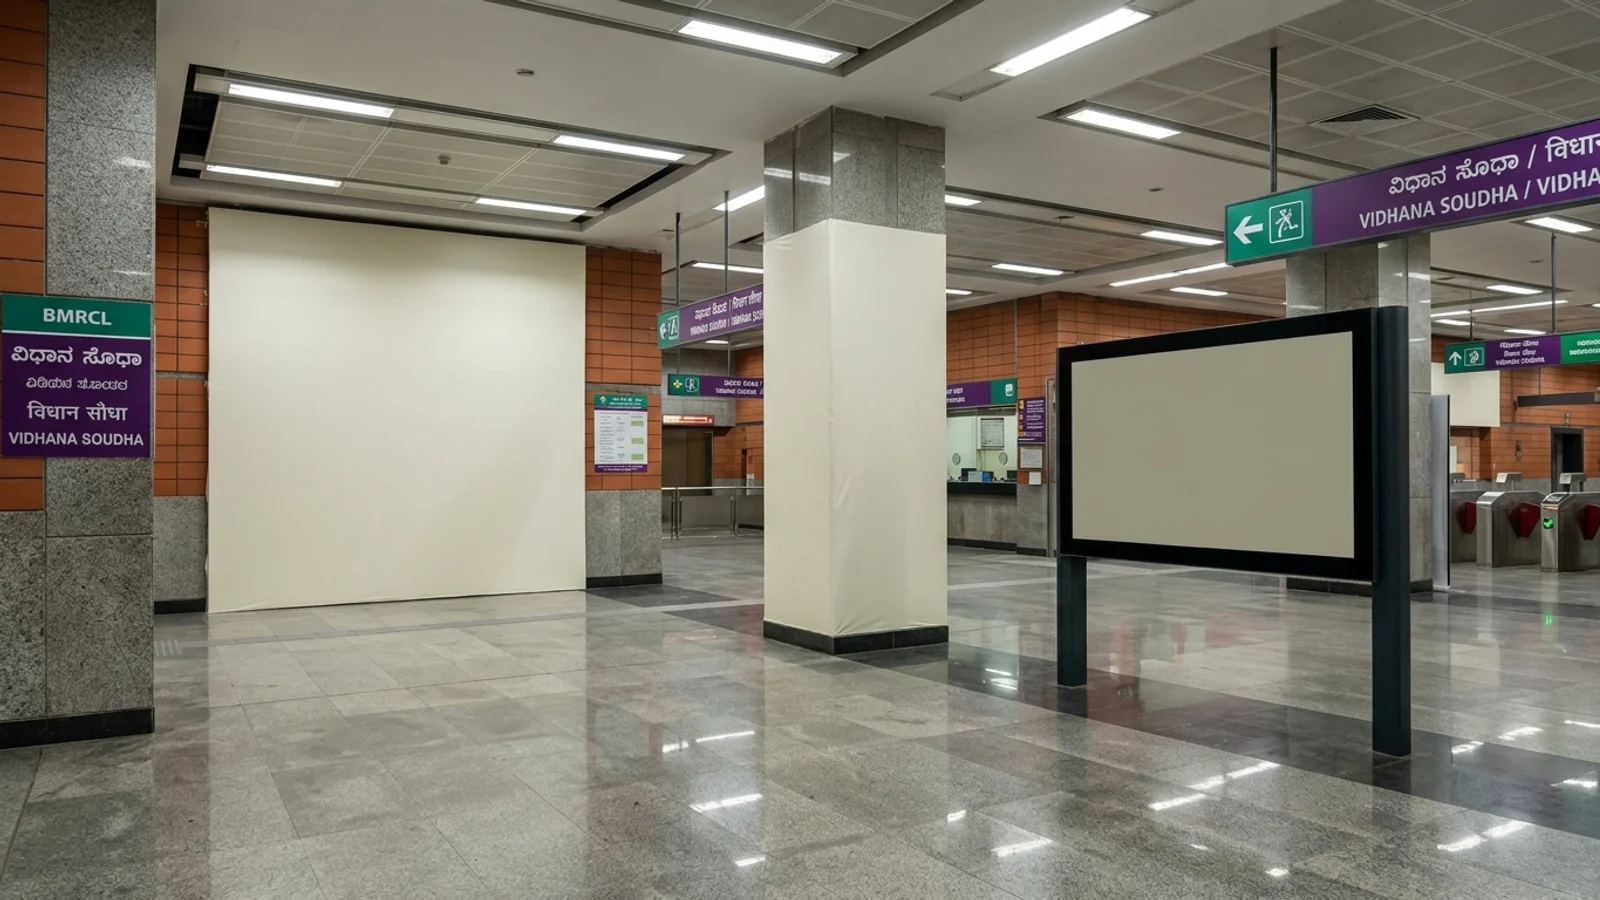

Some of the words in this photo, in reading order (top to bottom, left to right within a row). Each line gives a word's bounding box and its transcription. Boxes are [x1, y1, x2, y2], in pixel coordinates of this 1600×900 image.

[1389, 165, 1446, 195] ವಿಧಾನ
[1527, 144, 1537, 169] /
[1359, 200, 1436, 229] VIDHANA
[1440, 184, 1518, 214] SOUDHA
[1524, 180, 1531, 200] /
[43, 308, 112, 326] BMRCL
[11, 346, 73, 365] ವಿಧಾನ
[27, 400, 79, 420] विधान
[9, 432, 77, 445] VIDHANA
[82, 433, 144, 446] SOUDHA
